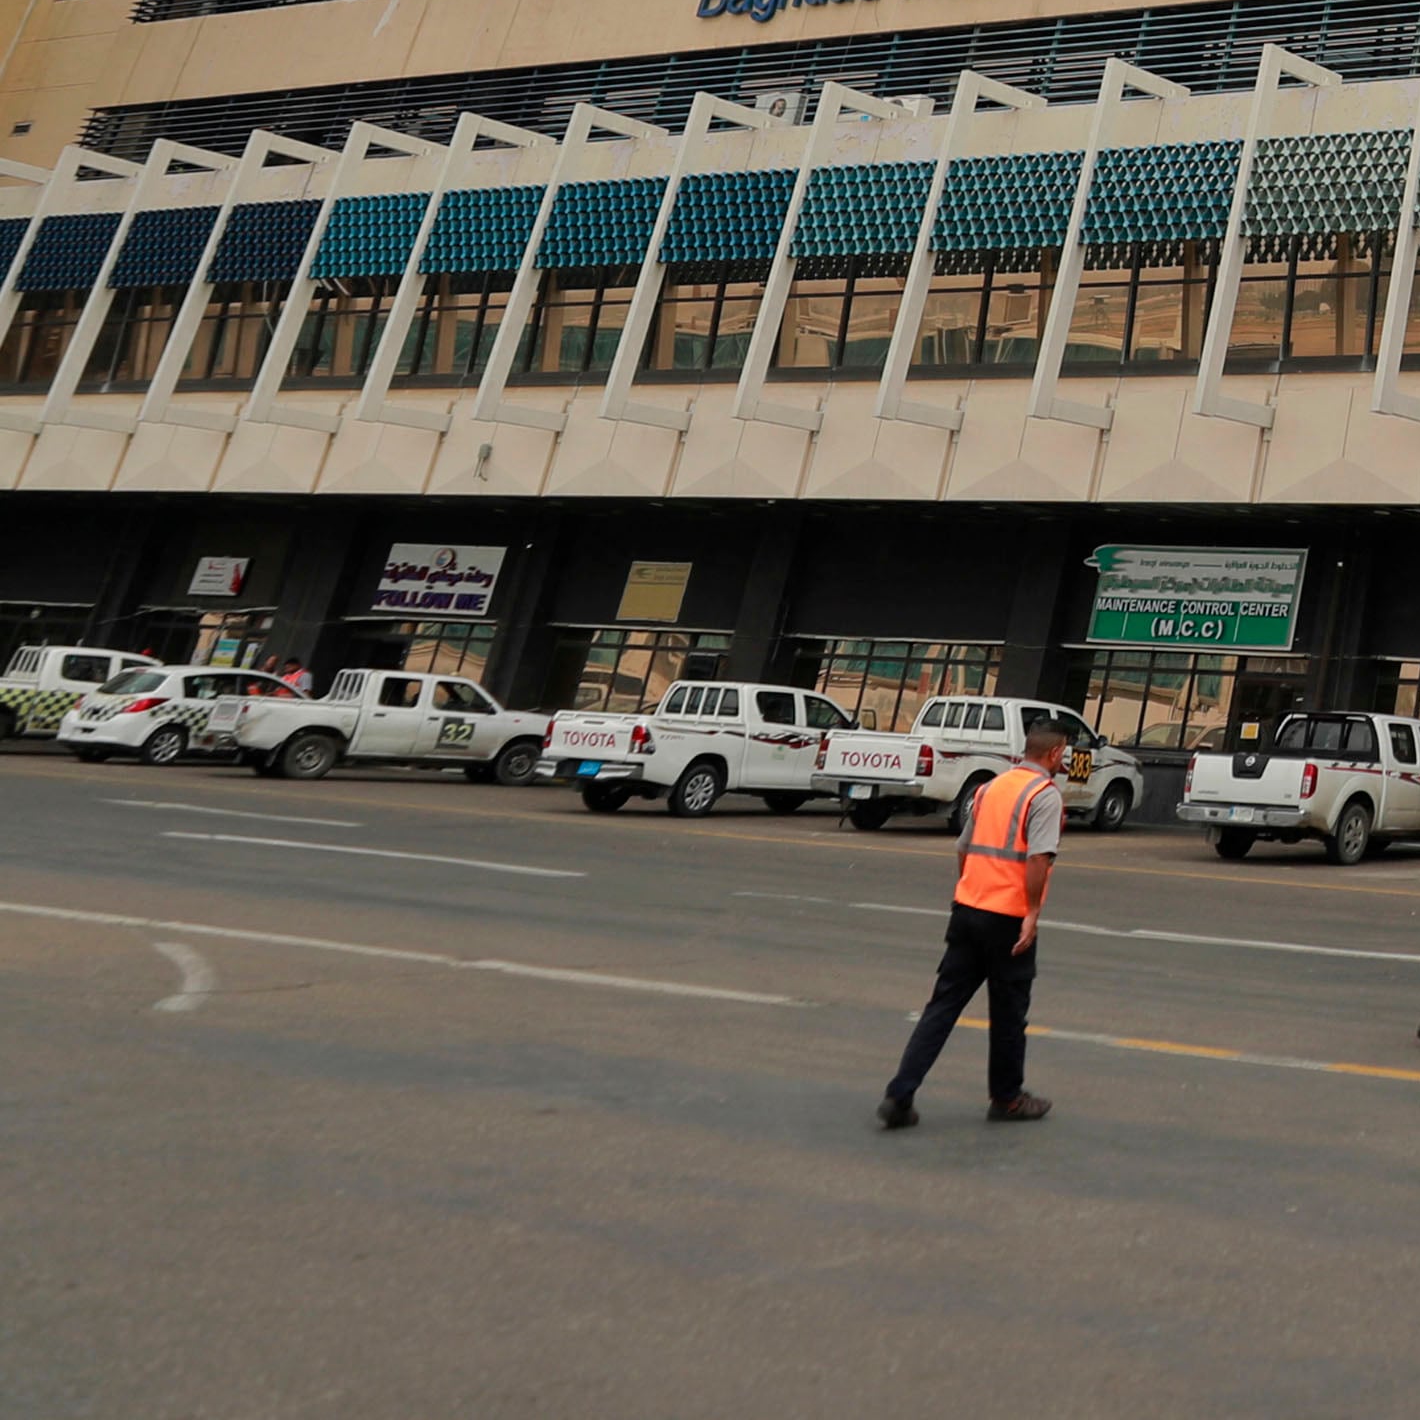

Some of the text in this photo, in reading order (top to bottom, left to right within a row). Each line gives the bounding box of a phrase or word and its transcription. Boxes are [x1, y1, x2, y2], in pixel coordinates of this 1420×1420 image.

[455, 593, 487, 611] ME
[1096, 598, 1288, 617] MAINTENANCE CONTROL CENTER
[441, 723, 473, 742] 32
[562, 731, 616, 748] TOYOTA
[841, 751, 901, 769] TOYOTA
[1069, 751, 1092, 778] 383
